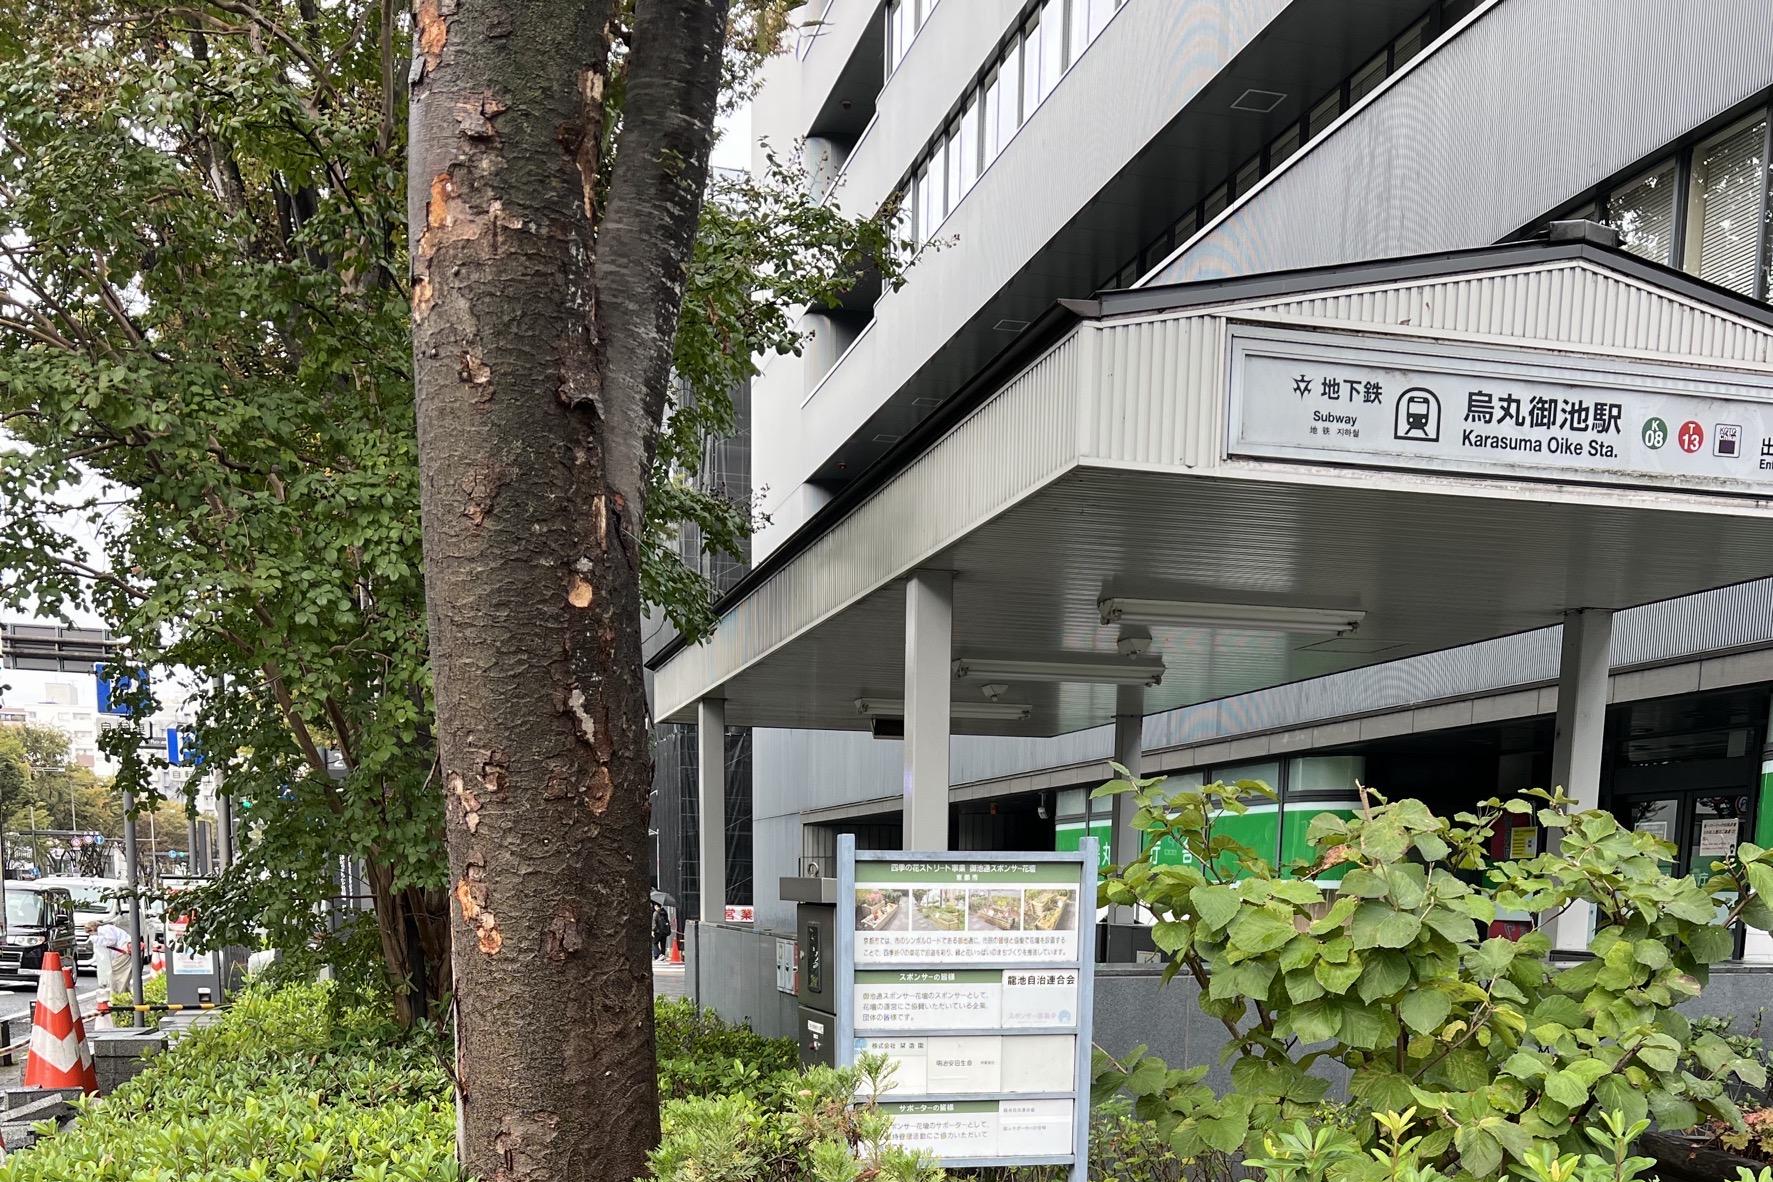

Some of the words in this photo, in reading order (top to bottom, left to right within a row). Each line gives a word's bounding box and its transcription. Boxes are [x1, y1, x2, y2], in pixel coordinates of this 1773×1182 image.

[1320, 376, 1383, 405] 地下鉄
[1313, 410, 1358, 427] Subway
[1463, 390, 1623, 435] 烏丸御池駅
[1651, 420, 1660, 431] K
[1688, 424, 1696, 435] T
[1462, 429, 1542, 453] Karasuma
[1547, 436, 1584, 456] Oike
[1588, 439, 1618, 459] Sta.
[1645, 430, 1664, 448] 08
[1682, 433, 1700, 451] 13
[899, 972, 956, 982] スポンサーの皆様
[1007, 974, 1075, 986] 龍池自治連合会
